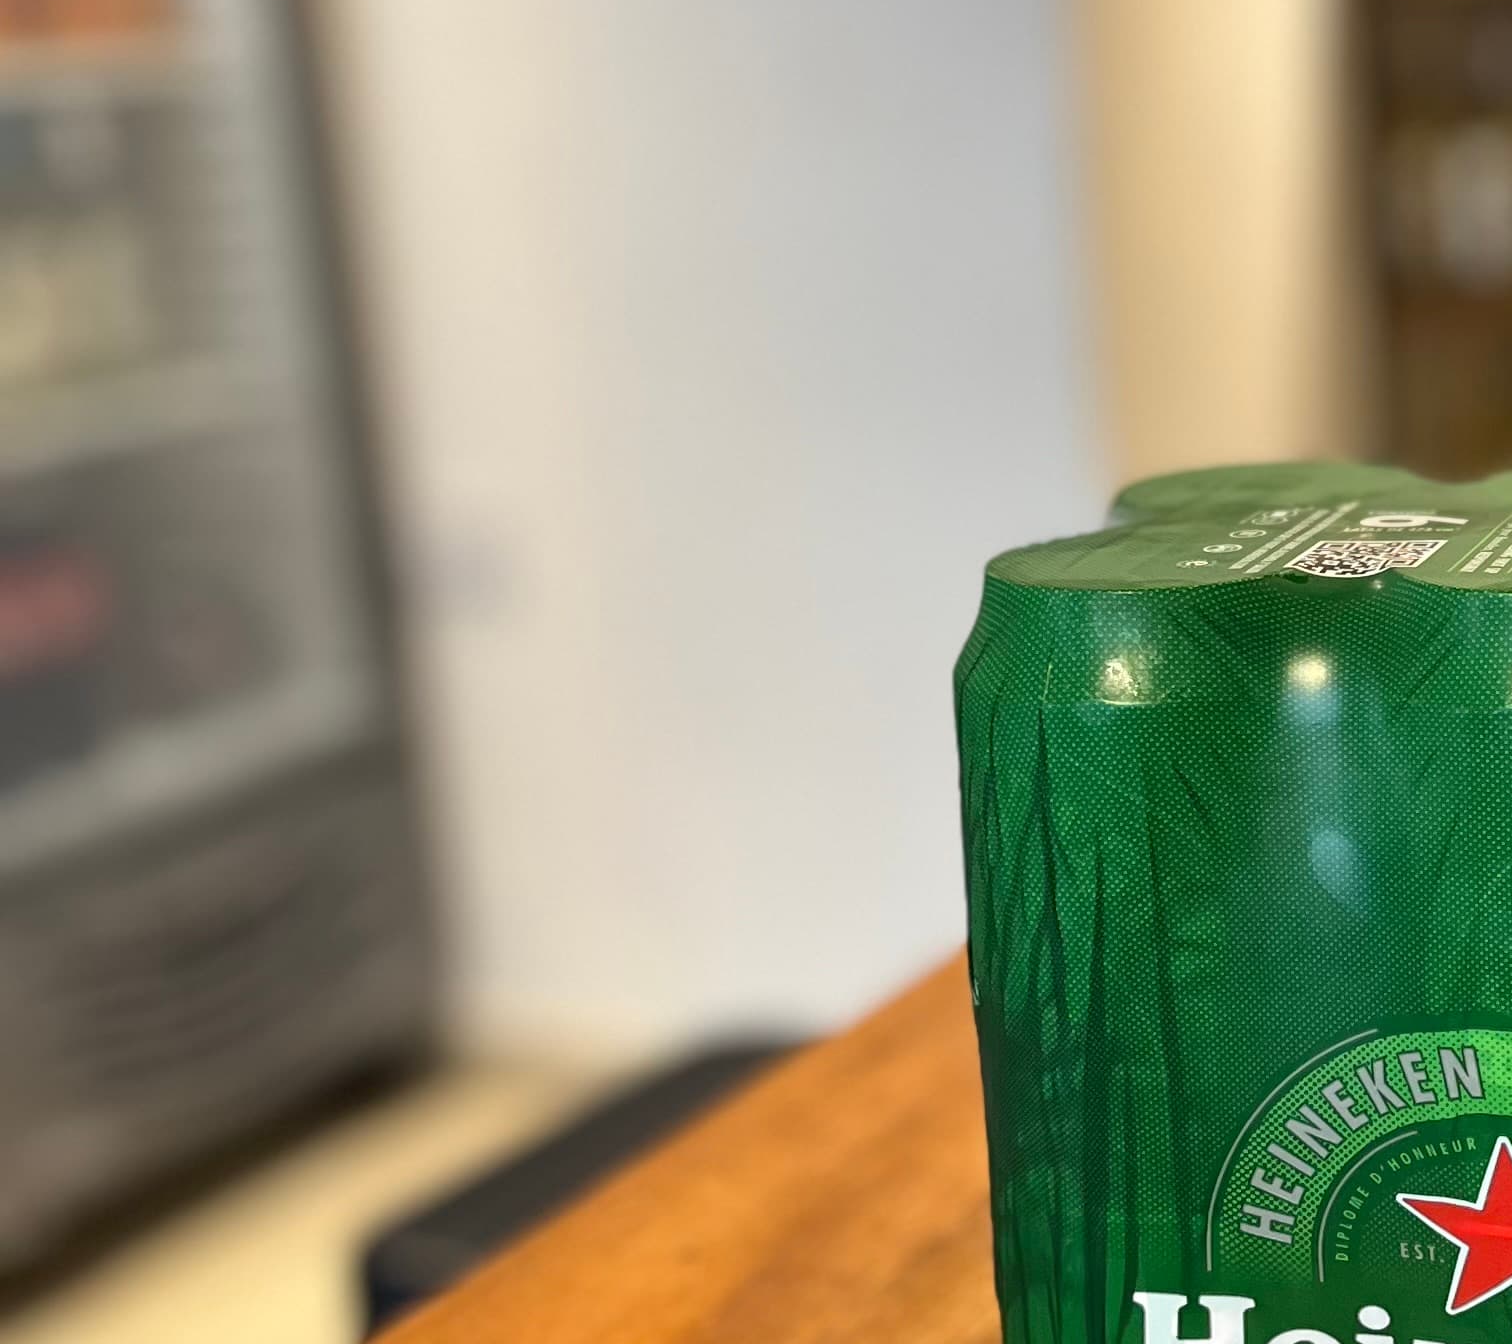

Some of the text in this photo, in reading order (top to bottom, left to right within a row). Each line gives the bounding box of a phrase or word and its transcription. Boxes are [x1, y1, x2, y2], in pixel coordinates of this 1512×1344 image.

[1239, 1045, 1486, 1245] HEINEKEN
[1370, 1137, 1477, 1185] D'HONNEUR
[1400, 1242, 1446, 1263] EST.
